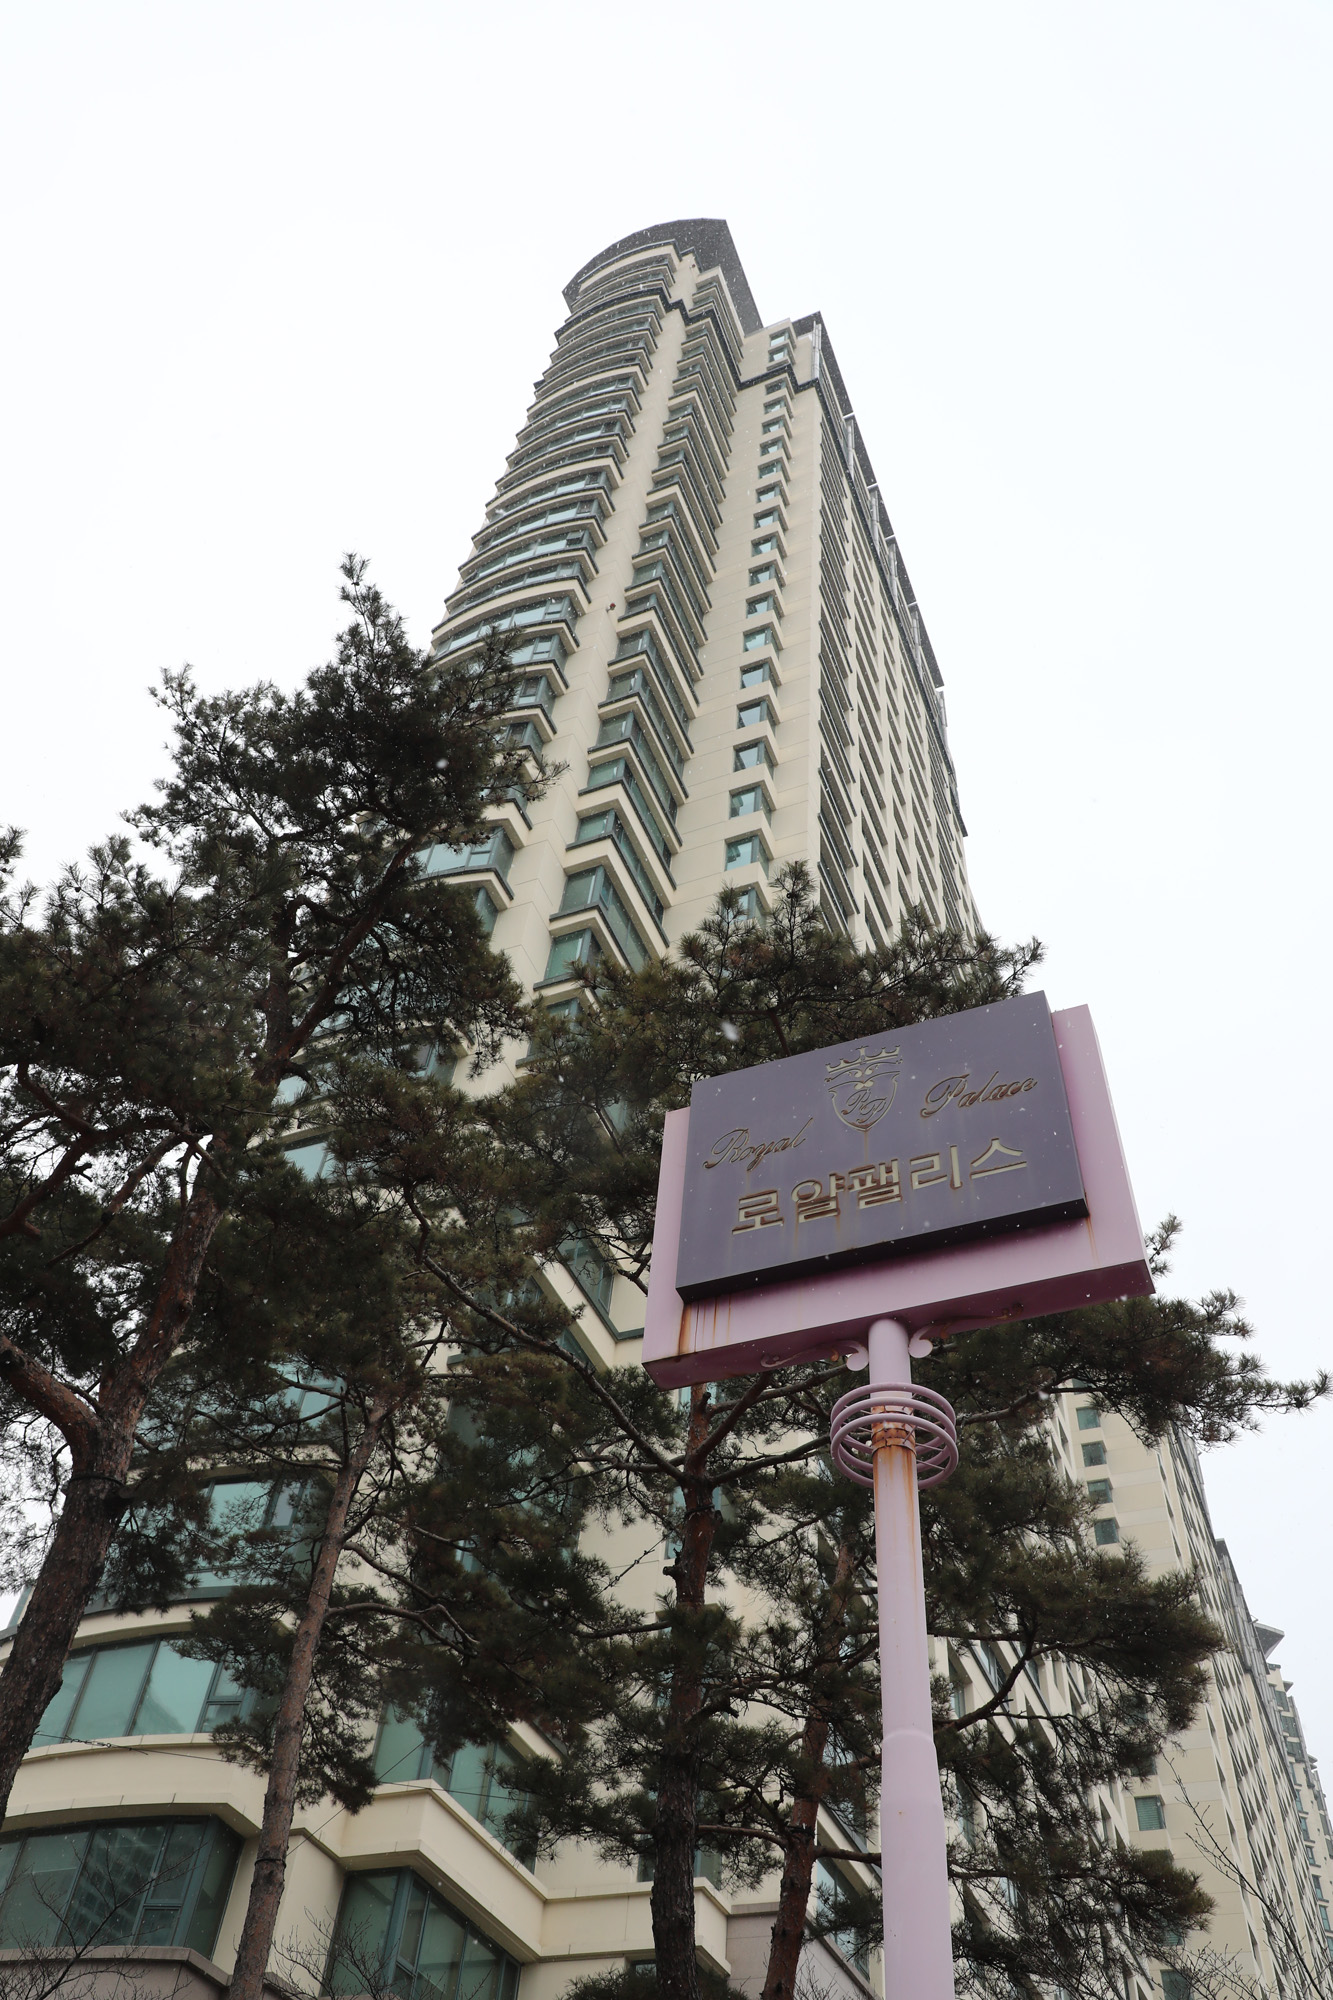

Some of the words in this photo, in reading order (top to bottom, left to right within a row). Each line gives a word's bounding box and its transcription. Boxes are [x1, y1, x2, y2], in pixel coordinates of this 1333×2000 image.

[703, 1117, 813, 1171] Royal
[920, 1071, 1038, 1118] Palace
[732, 1137, 1028, 1236] 로얄팰리스
